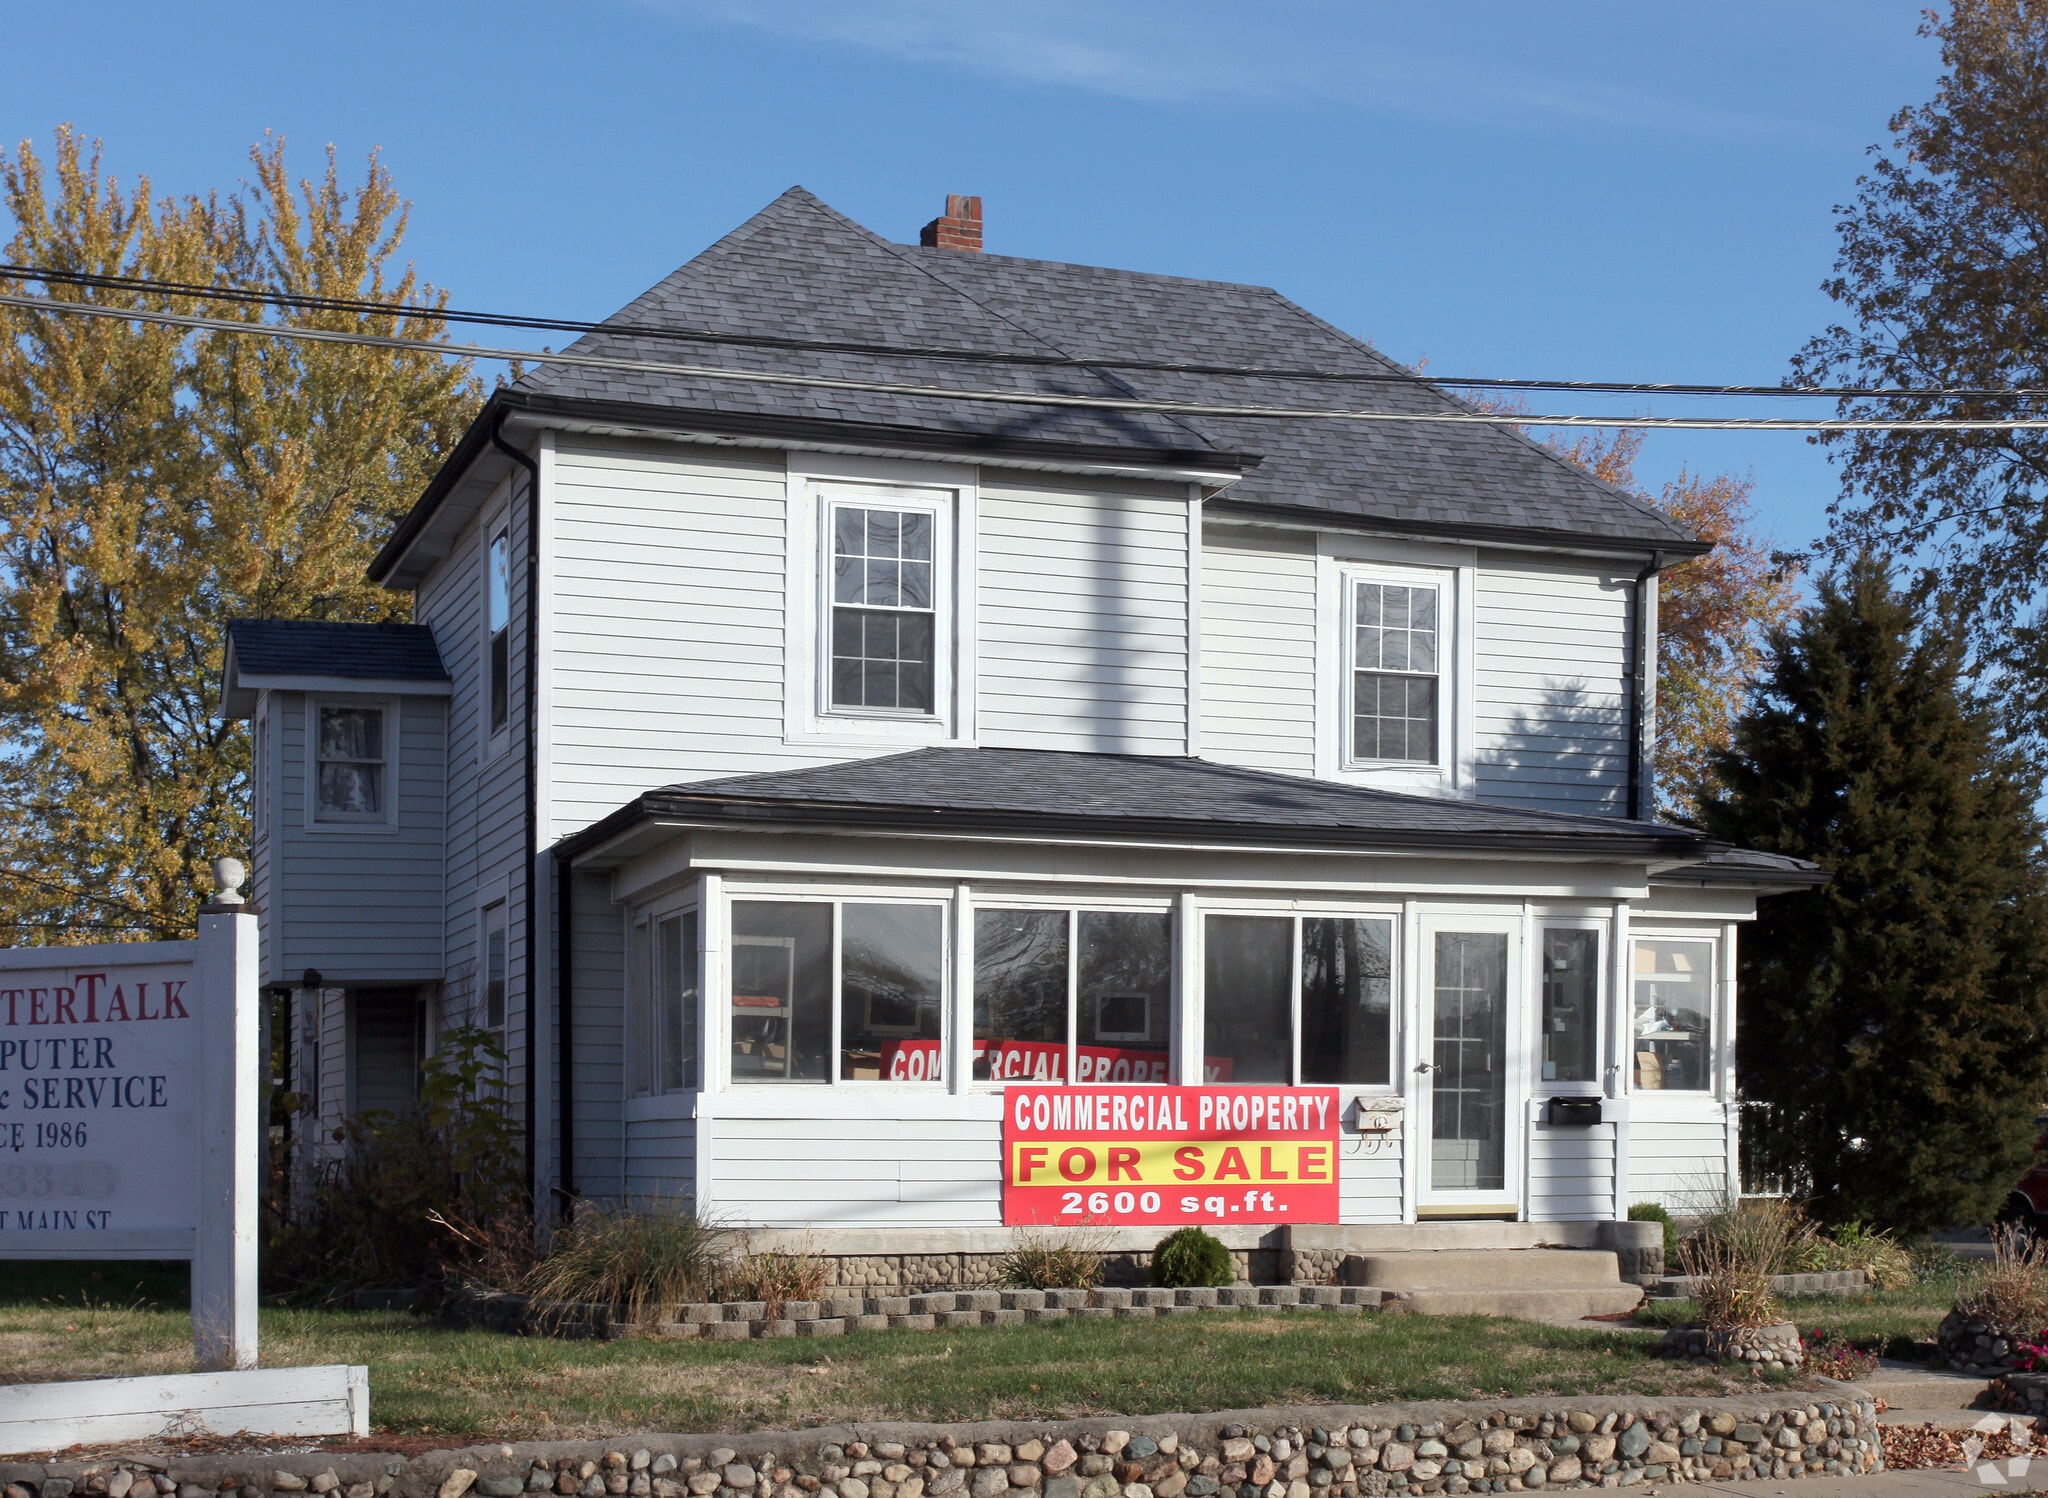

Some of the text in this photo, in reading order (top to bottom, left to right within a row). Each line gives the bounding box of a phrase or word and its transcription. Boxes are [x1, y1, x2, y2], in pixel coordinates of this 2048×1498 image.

[0, 1037, 116, 1071] PUTER
[890, 1049, 1221, 1082] COMRCIAL PROPEY
[23, 1075, 168, 1110] SERVICE
[1015, 1094, 1331, 1131] COMMERCIAL PROPERTY
[36, 1122, 87, 1148] 1986
[1018, 1146, 1328, 1182] FOR SALE
[18, 1210, 77, 1230] MAIN
[86, 1210, 112, 1230] ST
[1061, 1190, 1288, 1217] 2600 sq.ft.
